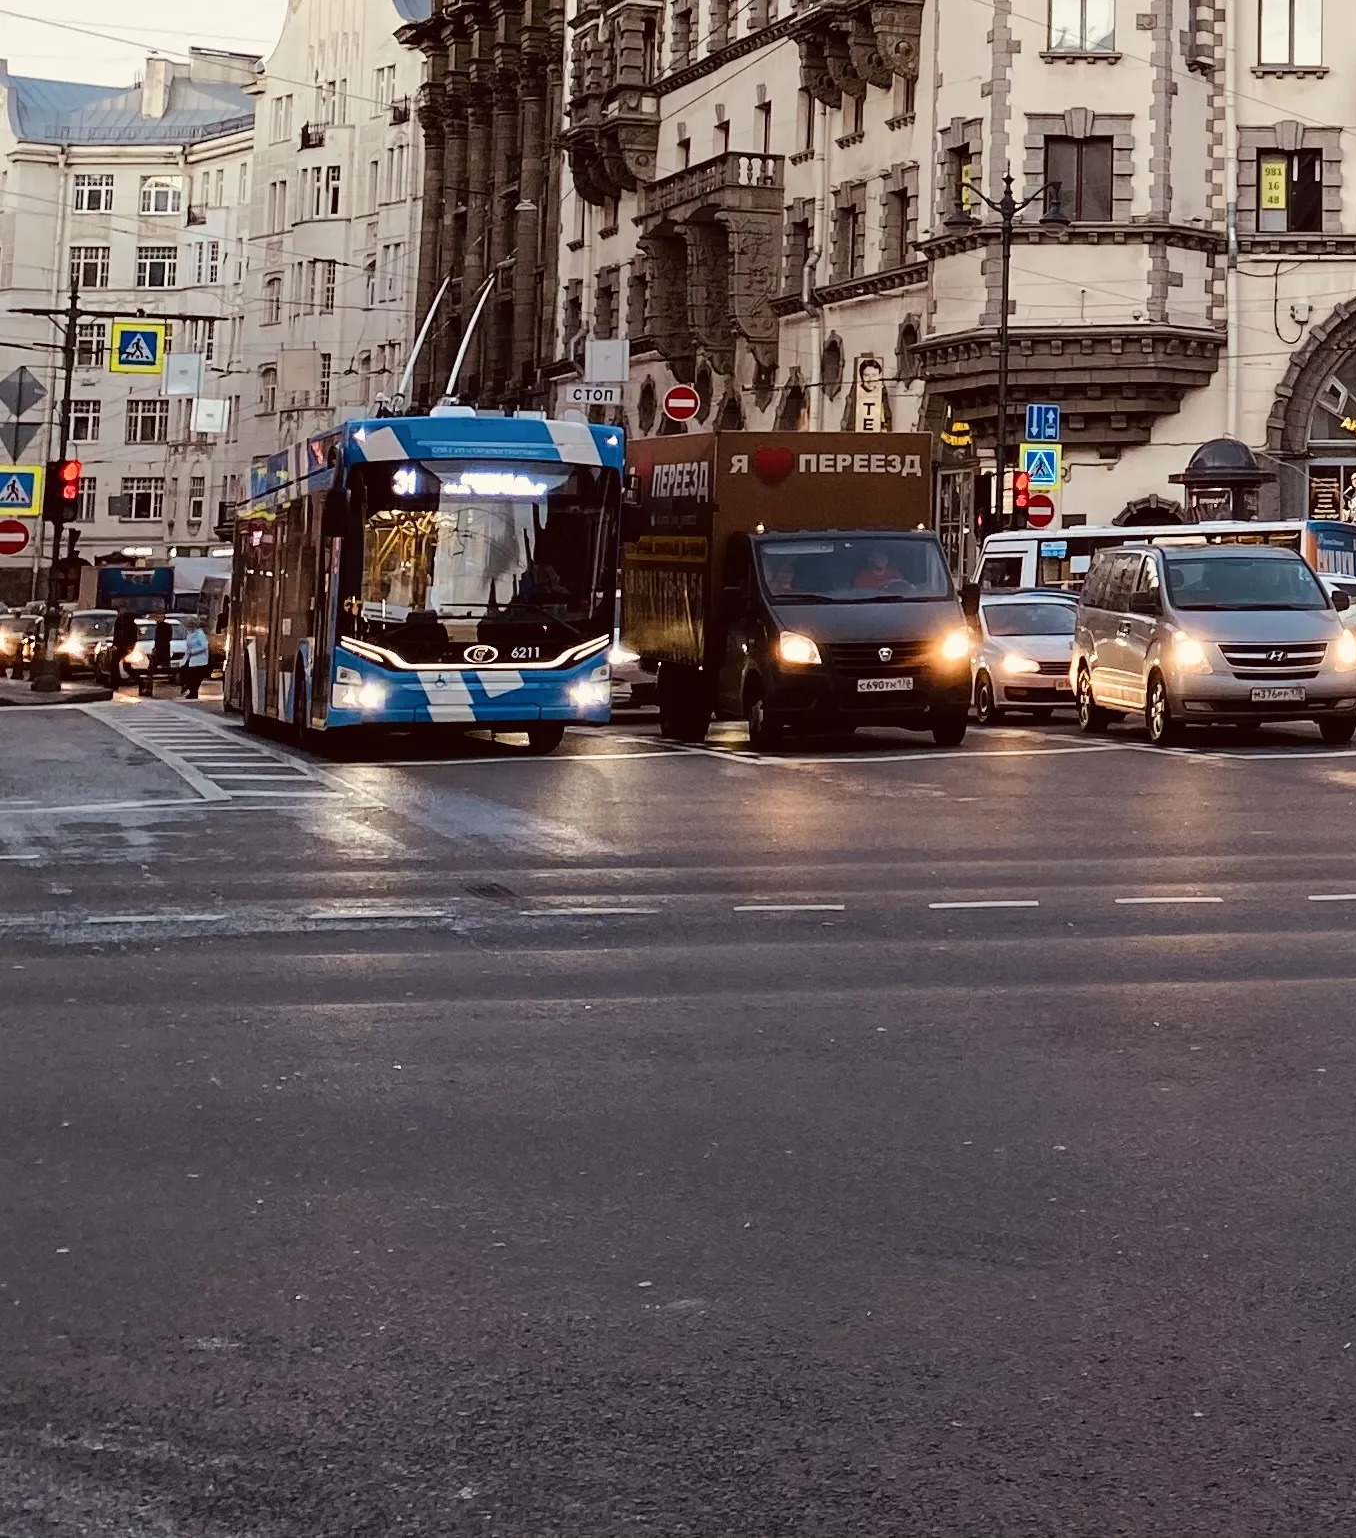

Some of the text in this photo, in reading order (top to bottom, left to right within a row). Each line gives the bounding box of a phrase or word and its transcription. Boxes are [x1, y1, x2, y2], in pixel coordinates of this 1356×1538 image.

[1264, 167, 1282, 176] 981
[1268, 182, 1280, 190] 16
[573, 388, 613, 401] СТОП
[863, 403, 875, 430] ТЕ
[729, 454, 922, 477] Я ПЕРЕЕЗД
[651, 462, 708, 502] ПЕРЕЕЗД
[511, 646, 540, 658] 6211
